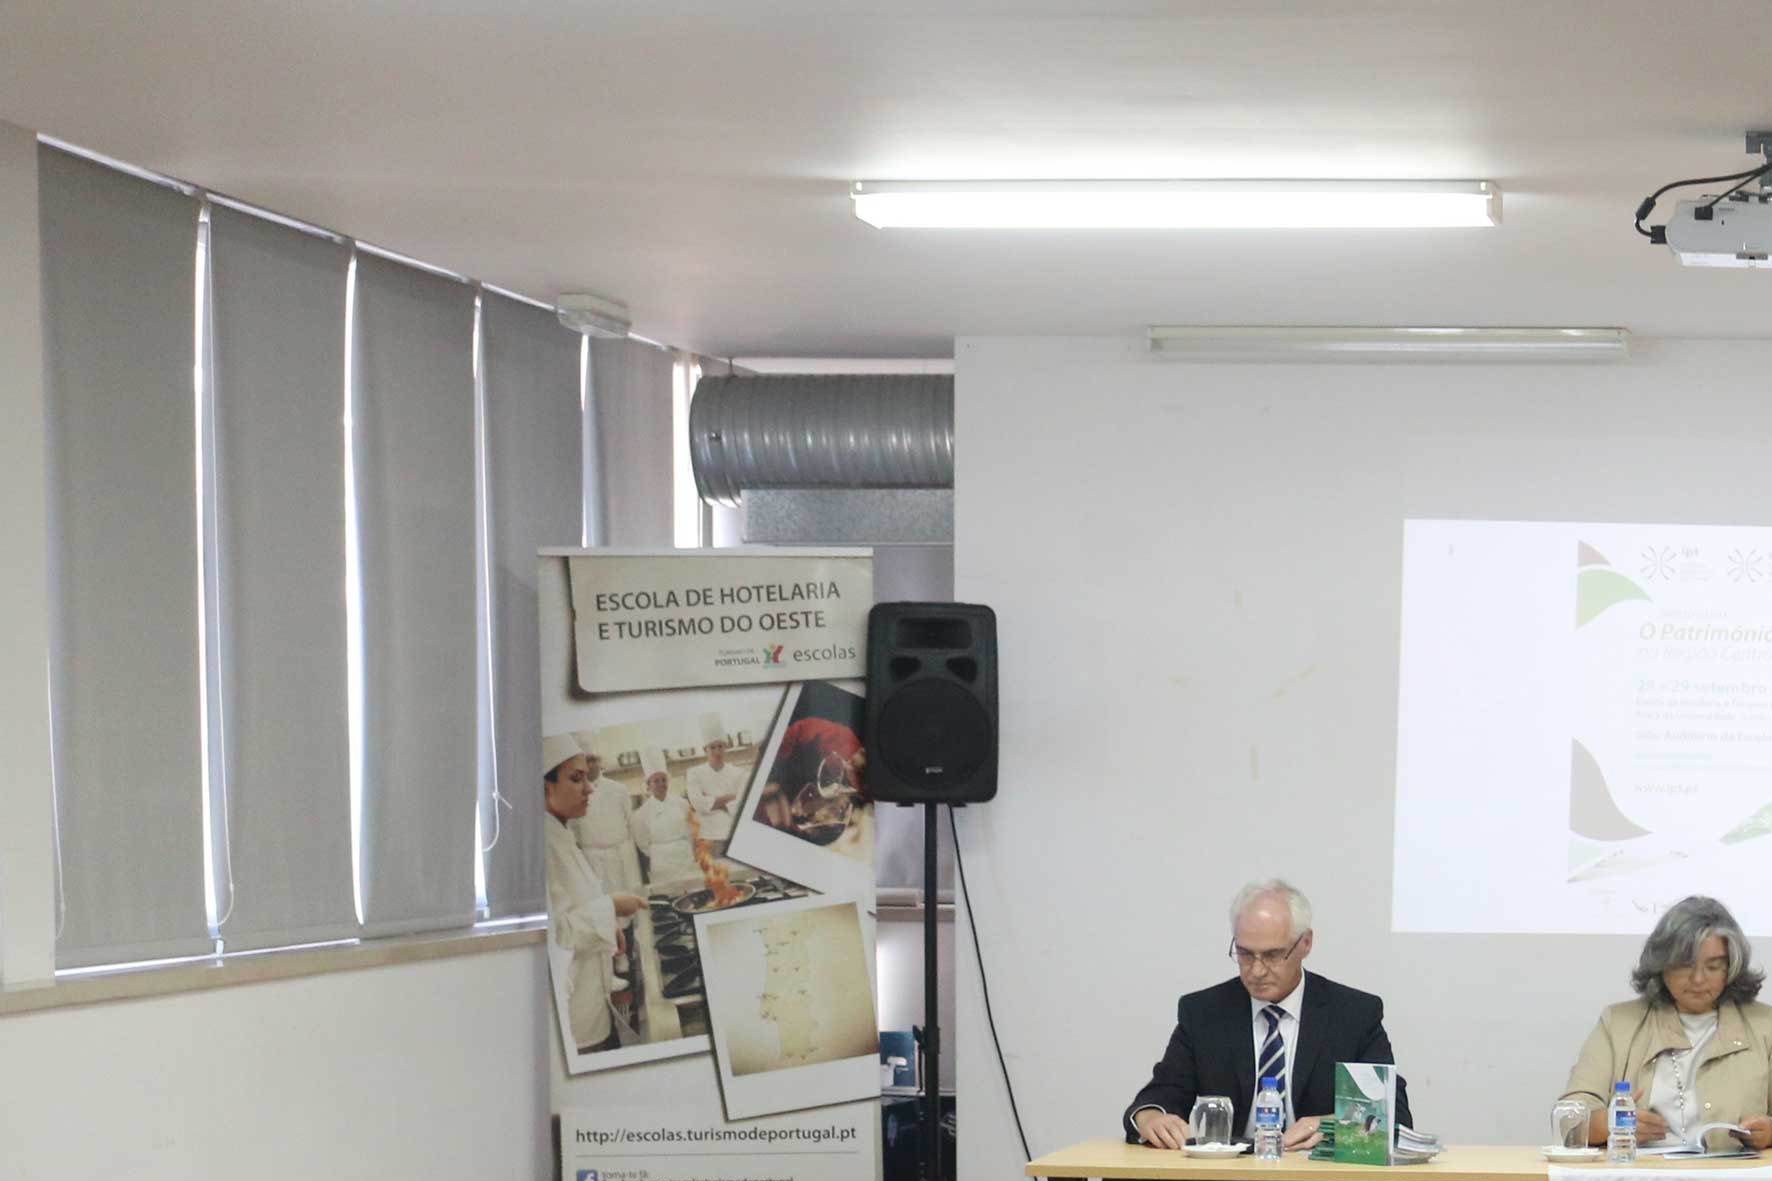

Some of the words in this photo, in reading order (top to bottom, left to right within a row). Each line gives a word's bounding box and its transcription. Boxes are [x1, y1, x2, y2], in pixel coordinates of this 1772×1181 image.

[596, 590, 680, 612] ESCOLA
[686, 587, 713, 606] DE
[720, 581, 841, 605] HOTELARIA
[598, 624, 610, 640] E
[616, 616, 715, 639] TURISMO
[720, 614, 753, 634] DO
[759, 610, 827, 632] OESTE
[1640, 621, 1657, 641] O
[715, 656, 761, 667] PORTUGAL
[793, 643, 857, 662] escolas
[575, 1126, 857, 1146] http://escolas.turismodeportugal.pt
